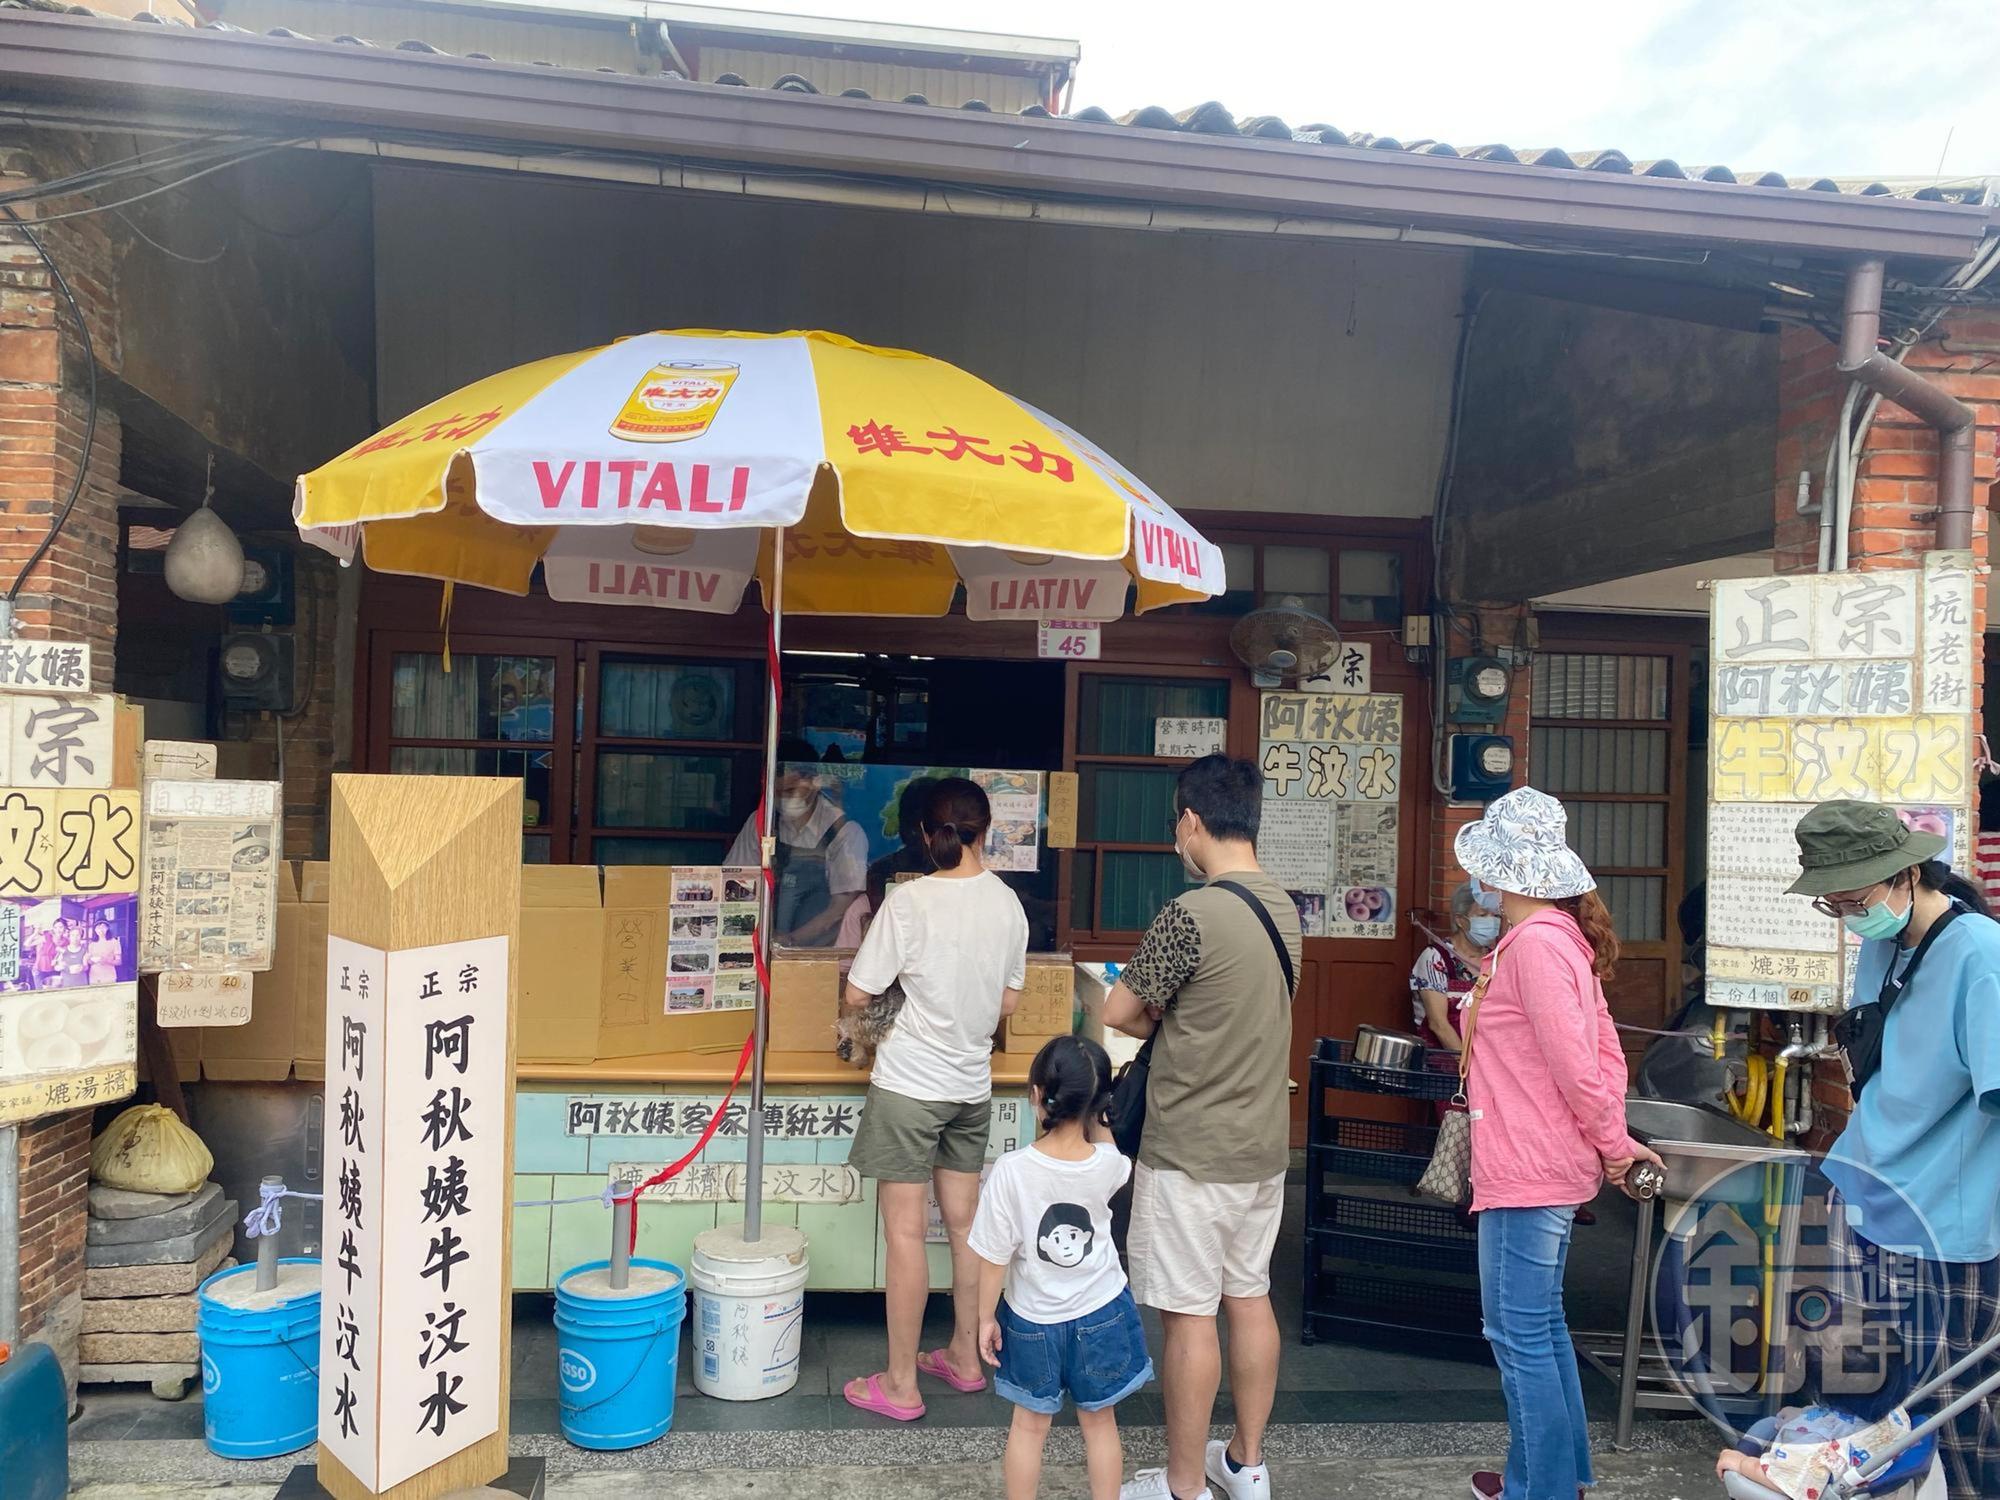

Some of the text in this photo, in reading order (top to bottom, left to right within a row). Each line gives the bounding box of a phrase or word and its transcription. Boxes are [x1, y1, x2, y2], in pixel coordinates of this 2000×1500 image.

[532, 461, 750, 512] VITALI
[1141, 520, 1201, 578] VITALI
[1725, 579, 1906, 659] 正宗
[1928, 555, 1968, 708] 三坑老街
[1059, 635, 1086, 655] 45
[1717, 664, 1911, 715] 阿秋姨
[25, 695, 99, 786] 宗
[1160, 720, 1221, 735] 營業時間
[1262, 695, 1400, 742] 阿秋姨
[1263, 743, 1397, 798] 牛汶水
[1718, 717, 1963, 802] 牛汶水
[0, 907, 18, 978] 年代新聞
[222, 976, 238, 988] 40
[341, 966, 369, 999] 正宗
[419, 963, 478, 1000] 正宗
[1710, 987, 1833, 1008] 一份4個 40 元
[231, 1006, 247, 1018] 60
[568, 1101, 865, 1137] 阿秋姨客家傳統米
[334, 1014, 367, 1439] 阿秋姨牛汶水
[415, 1013, 476, 1437] 阿秋姨牛汶水
